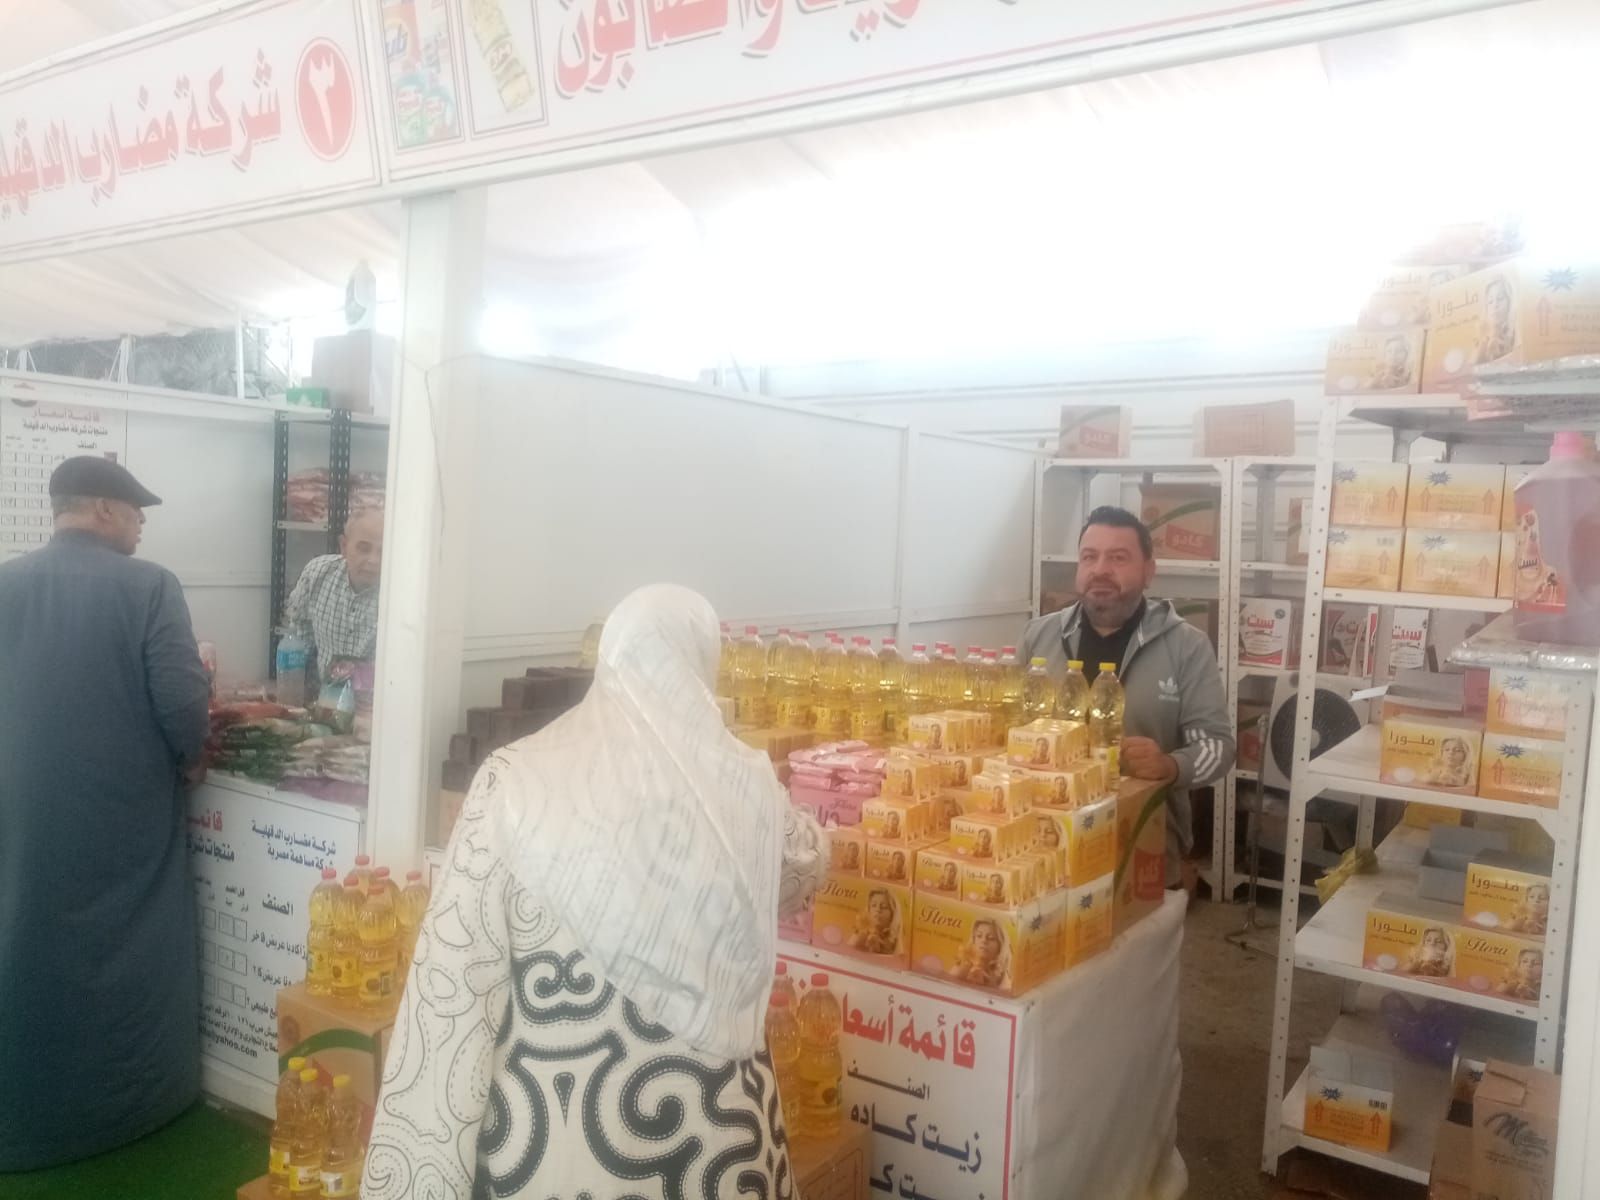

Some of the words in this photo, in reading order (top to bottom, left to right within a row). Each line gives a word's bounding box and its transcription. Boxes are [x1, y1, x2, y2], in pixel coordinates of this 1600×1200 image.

[184, 47, 282, 171] شركة
[76, 84, 180, 206] مضارب
[267, 842, 290, 861] مصرية
[311, 833, 336, 856] شركة
[289, 849, 315, 868] مساهمة
[822, 879, 859, 901] Flora
[262, 893, 294, 916] الصنف
[918, 904, 963, 930] Flora
[1466, 936, 1509, 956] Flora
[841, 992, 895, 1049] أسعا
[897, 1004, 977, 1070] قائمة
[847, 1060, 930, 1101] الصنف
[922, 1123, 982, 1175] زيت
